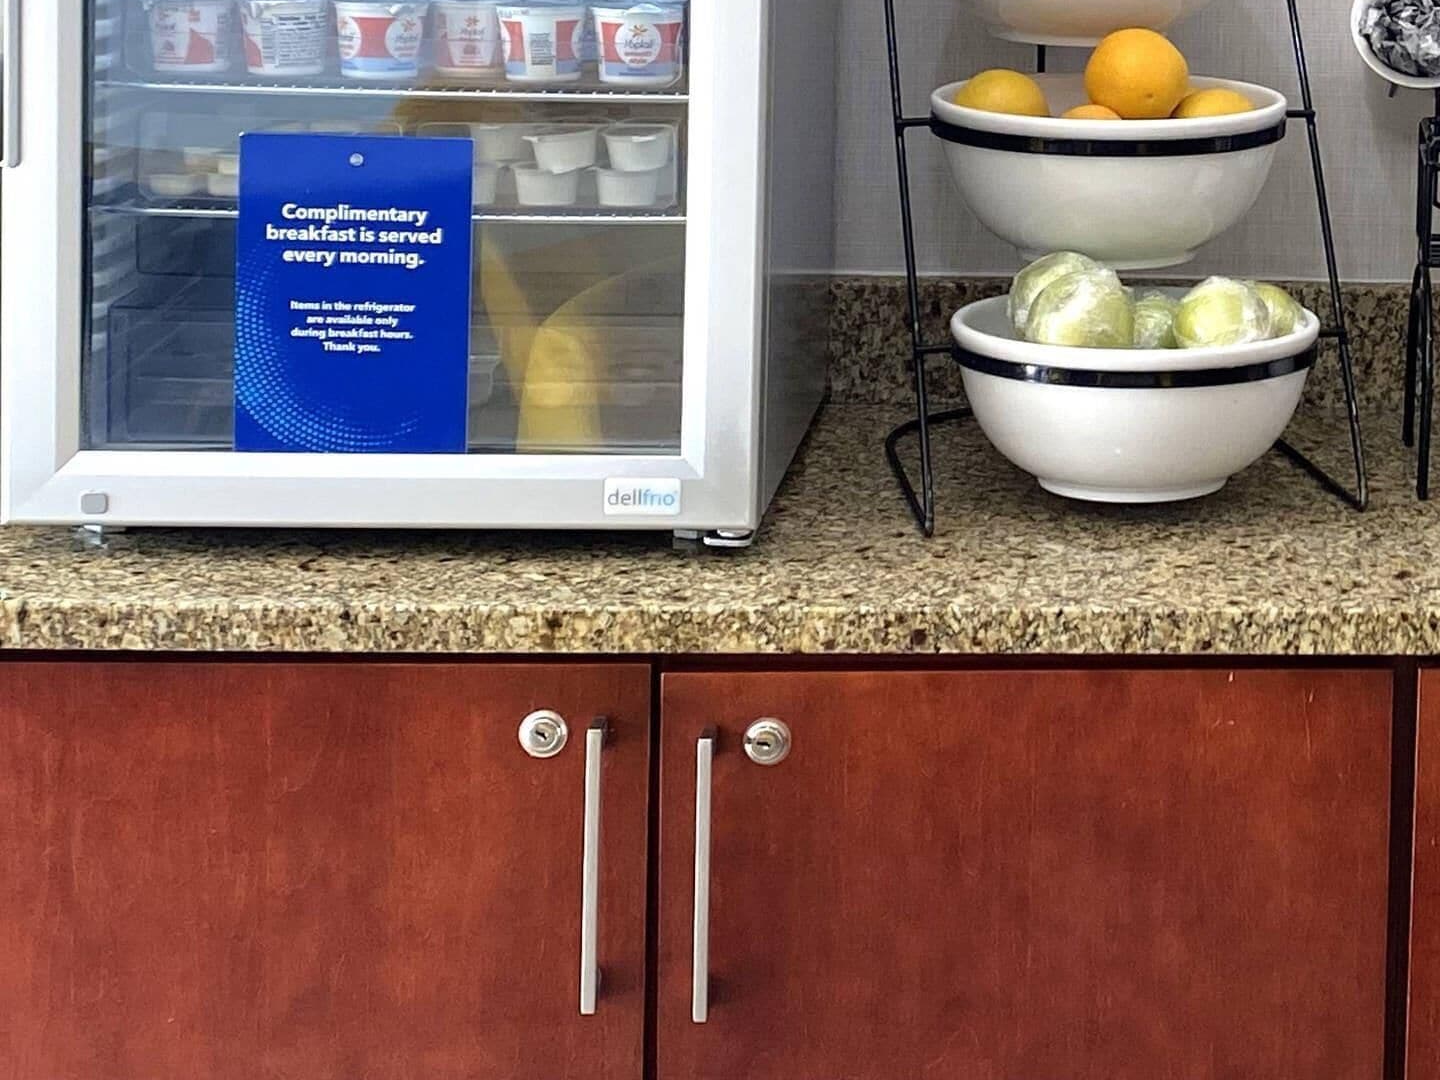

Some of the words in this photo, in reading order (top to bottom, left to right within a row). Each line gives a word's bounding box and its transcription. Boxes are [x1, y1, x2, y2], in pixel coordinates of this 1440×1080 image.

[282, 203, 428, 226] Complimentary
[266, 224, 356, 241] breakfast
[360, 227, 375, 242] is
[378, 228, 442, 244] served
[283, 249, 335, 267] every
[340, 249, 425, 268] morning.
[290, 300, 320, 310] Items
[322, 301, 332, 310] in
[334, 301, 352, 311] the
[354, 301, 416, 314] refrigerator
[306, 316, 324, 324] are
[326, 314, 373, 324] available
[375, 316, 398, 328] only
[290, 327, 326, 340] during
[328, 327, 378, 338] breakfast
[380, 329, 413, 339] hours.
[322, 341, 355, 351] Thank
[358, 344, 380, 354] you.
